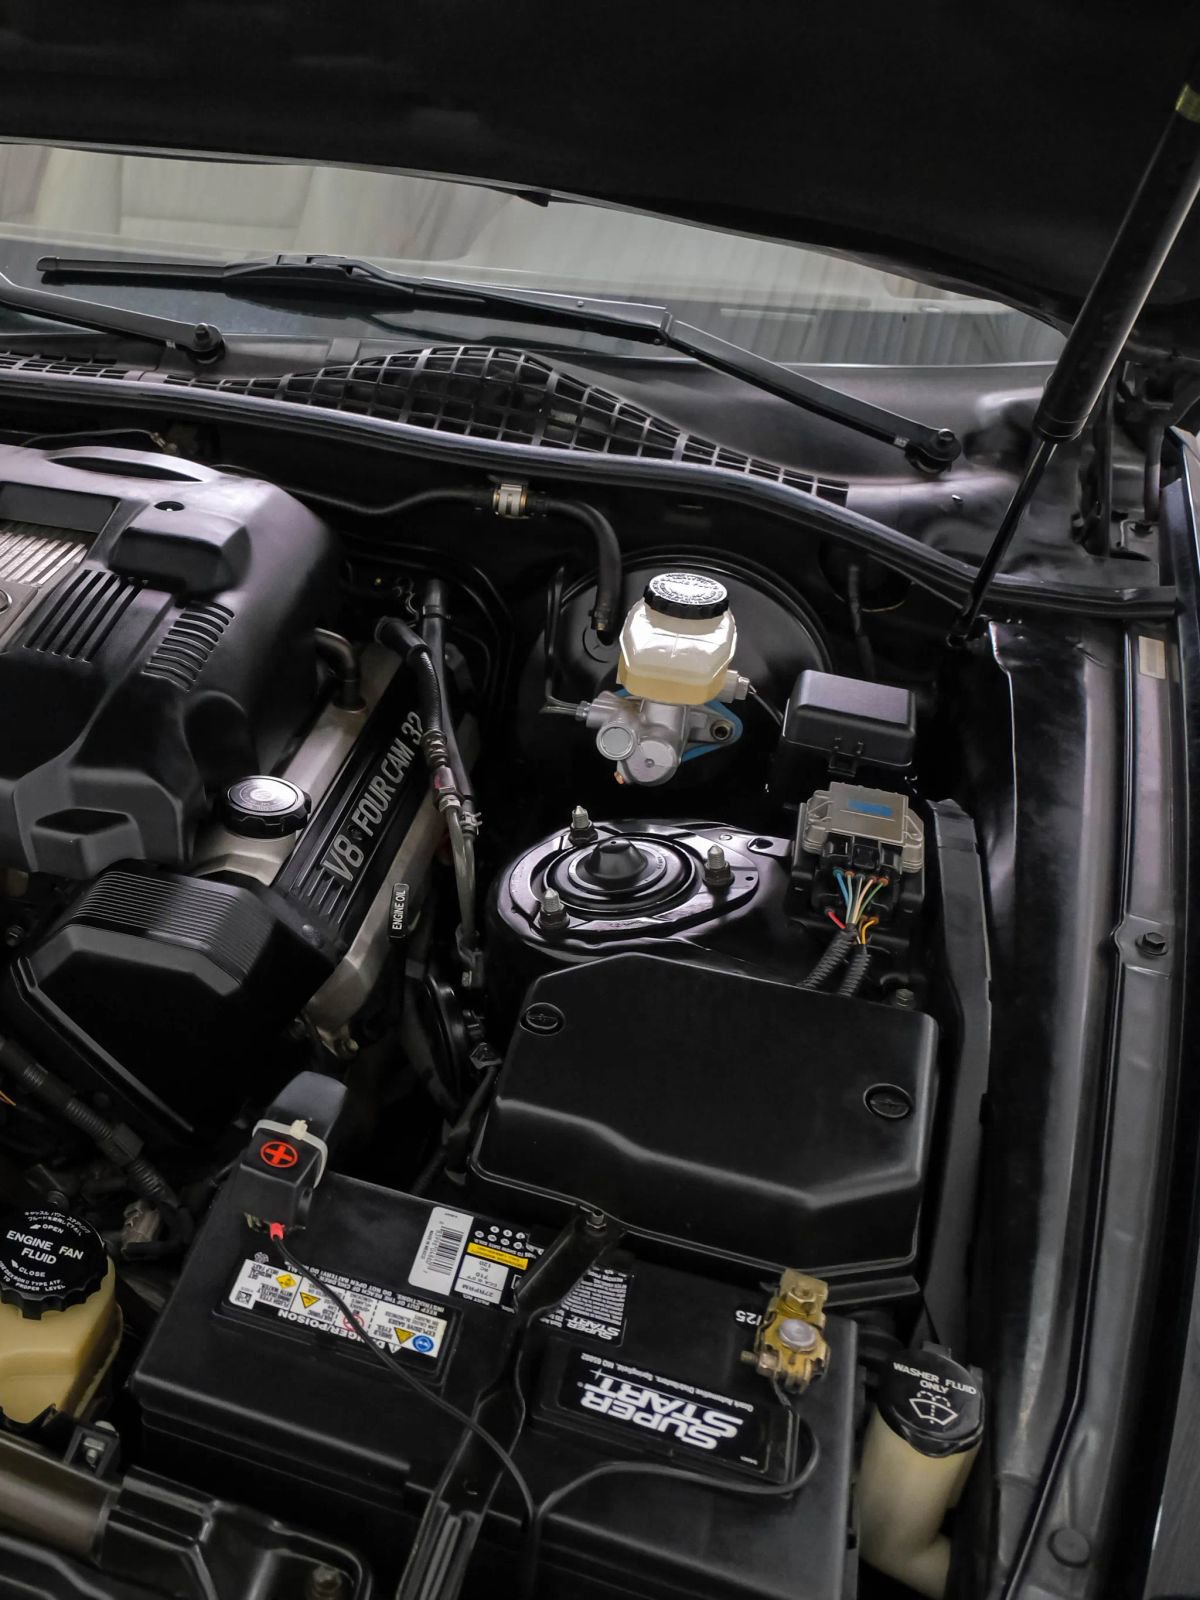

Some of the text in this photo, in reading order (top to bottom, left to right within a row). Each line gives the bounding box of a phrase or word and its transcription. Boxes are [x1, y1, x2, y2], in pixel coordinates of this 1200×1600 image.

[322, 834, 365, 886] V8
[351, 775, 397, 837] FOUR
[381, 737, 415, 784] CAM
[392, 889, 406, 930] ENGINE OIL
[42, 1223, 64, 1235] OPEN
[6, 1229, 84, 1260] ENGINE FAN
[21, 1247, 57, 1265] FLUID
[18, 1266, 46, 1278] CLOSE
[476, 1272, 488, 1280] 710
[15, 1282, 40, 1291] PROPER
[44, 1284, 66, 1292] LEVEL
[350, 1279, 367, 1289] OPEN
[367, 1285, 381, 1293] NOT
[361, 1289, 383, 1300] REACH
[420, 1307, 438, 1316] KEEP
[277, 1309, 386, 1349] DNGER/POISON
[566, 1321, 612, 1340] SUPER
[892, 1362, 977, 1395] WASHER FLUID
[919, 1380, 950, 1394] ONLY
[583, 1377, 744, 1438] START
[580, 1391, 718, 1450] SUPER
